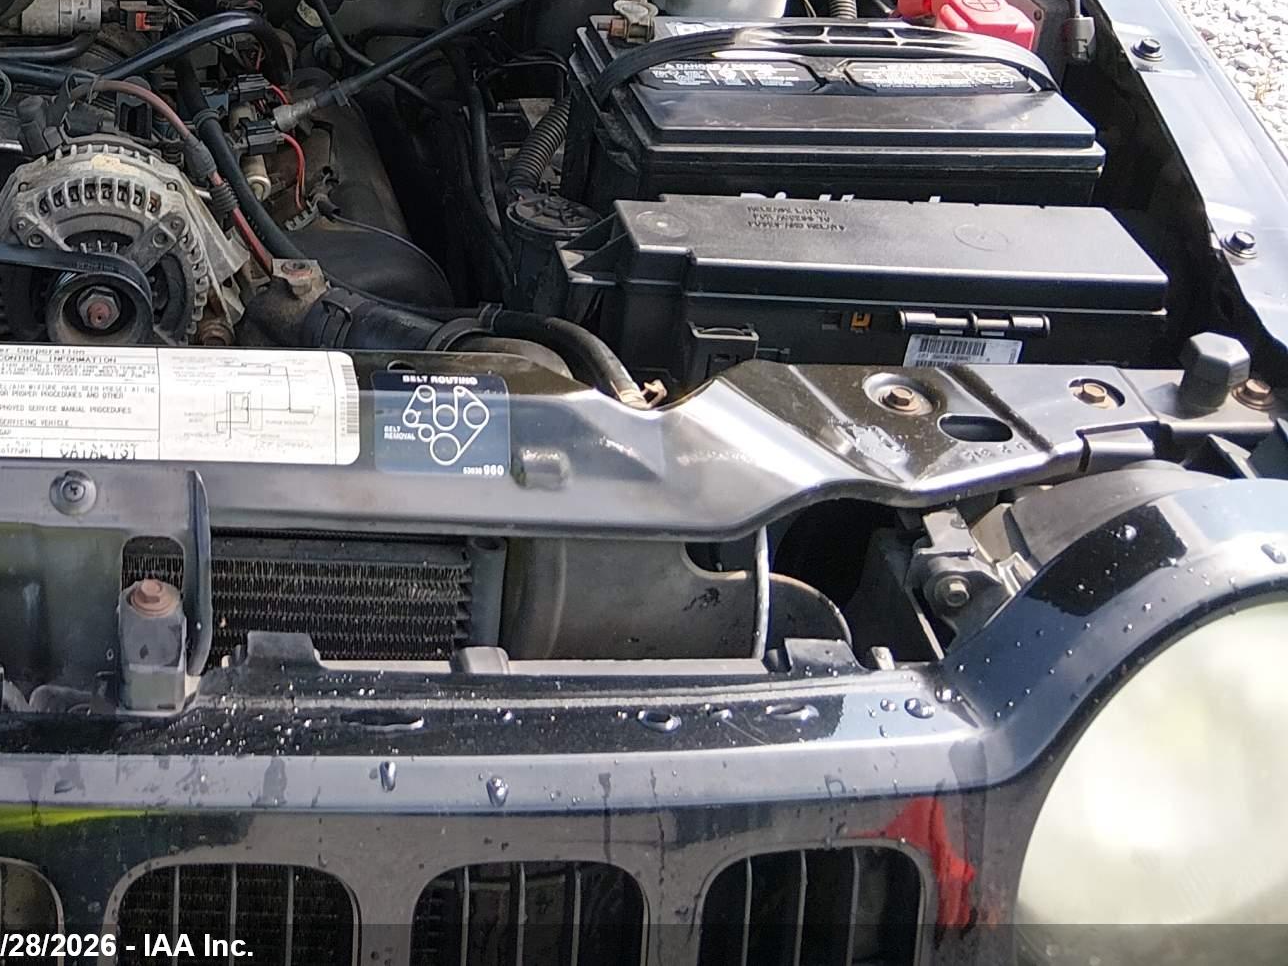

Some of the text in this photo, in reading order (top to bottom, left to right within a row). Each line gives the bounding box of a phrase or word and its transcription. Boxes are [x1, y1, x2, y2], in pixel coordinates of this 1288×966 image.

[403, 375, 478, 385] BELT ROUTING
[384, 432, 416, 440] REMOVAL
